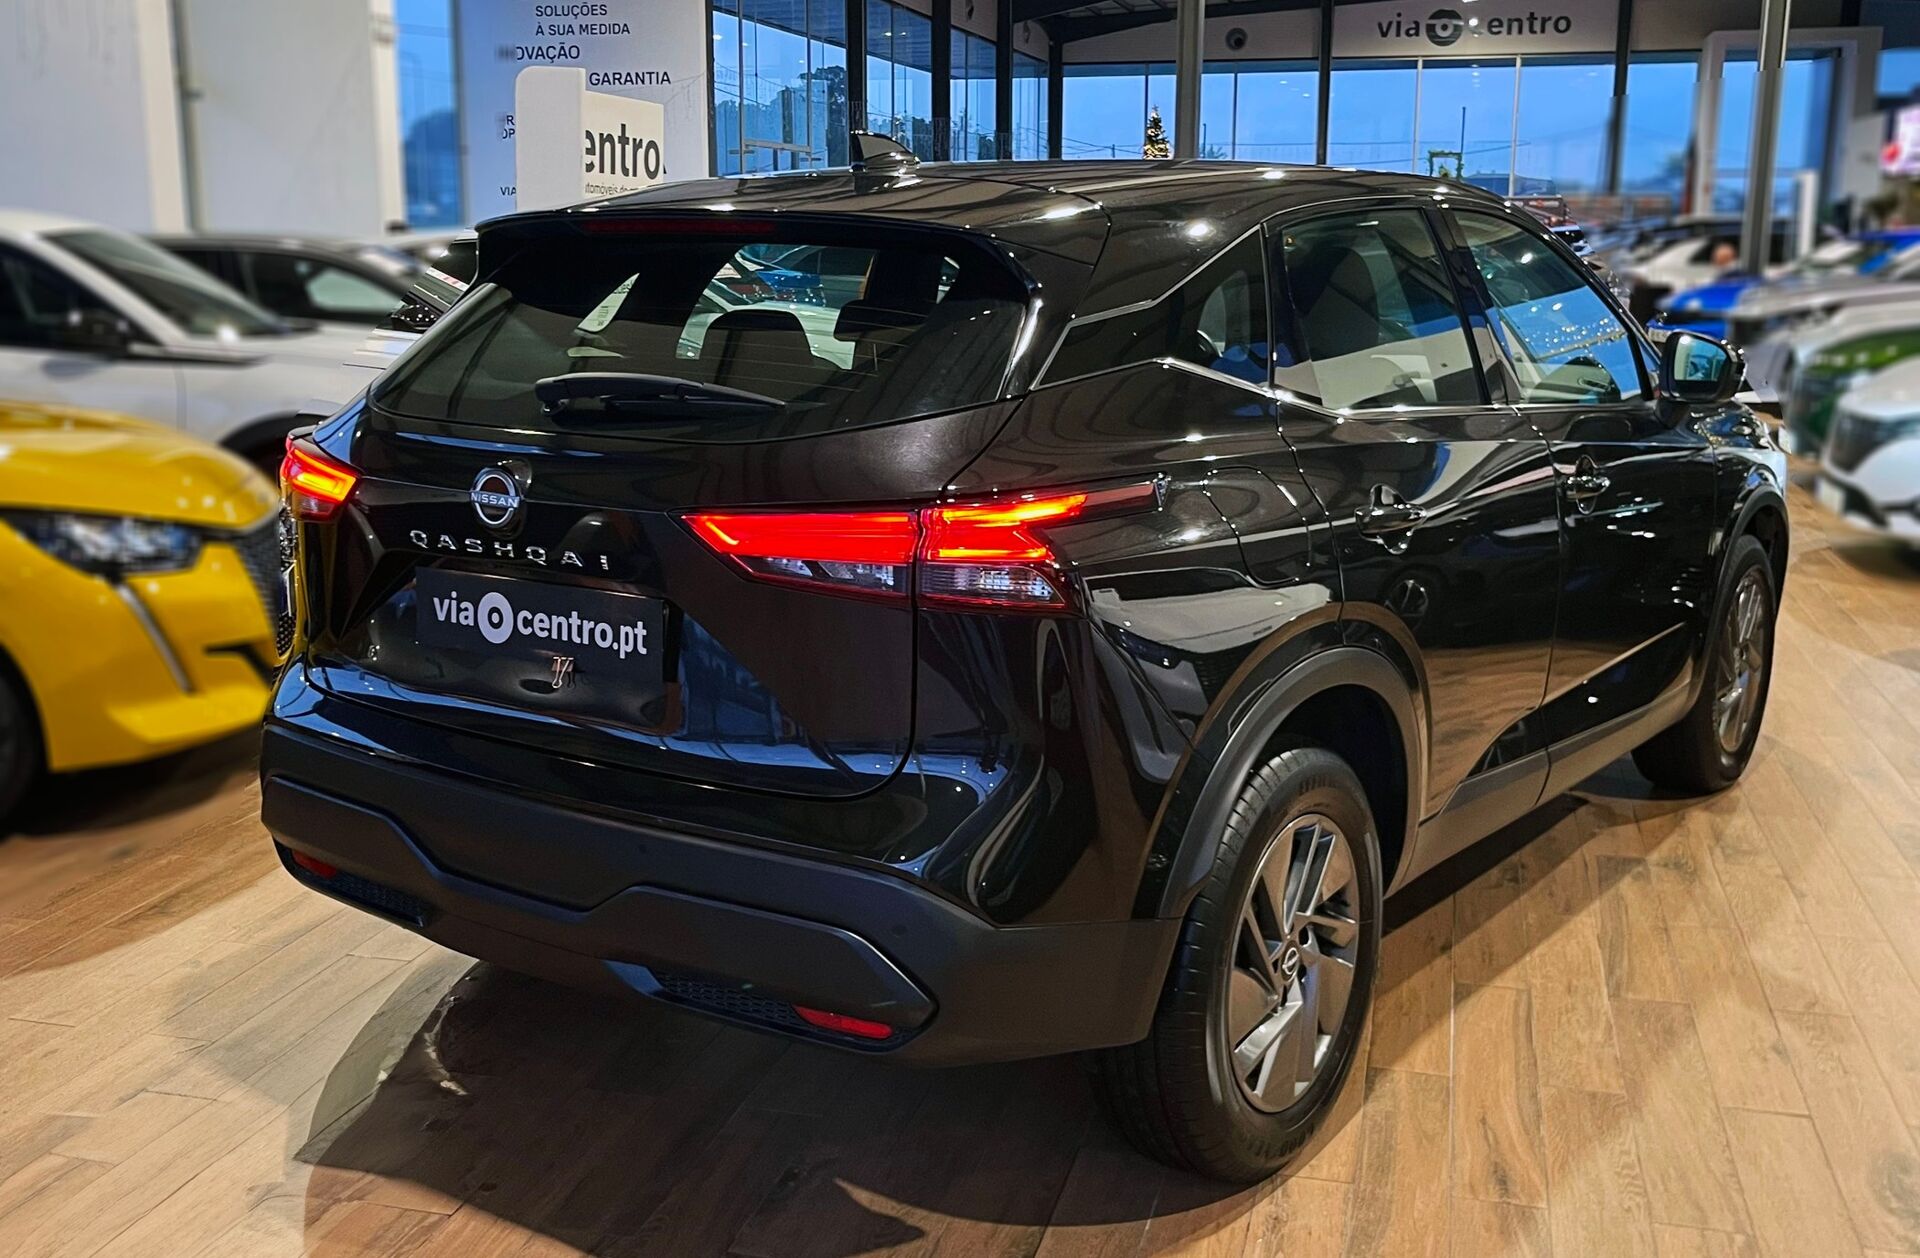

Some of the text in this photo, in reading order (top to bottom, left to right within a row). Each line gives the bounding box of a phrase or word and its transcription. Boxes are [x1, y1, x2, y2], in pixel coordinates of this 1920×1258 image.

[535, 2, 608, 19] SOLUÇÕES
[535, 22, 631, 36] À SUA MEDIDA
[1377, 12, 1572, 38] via entro
[497, 42, 580, 63] OVAÇÃO
[589, 71, 671, 86] GARANTIA
[471, 492, 519, 508] NISSAN
[409, 529, 609, 570] QASHQAI
[433, 591, 648, 659] via centro.pt
